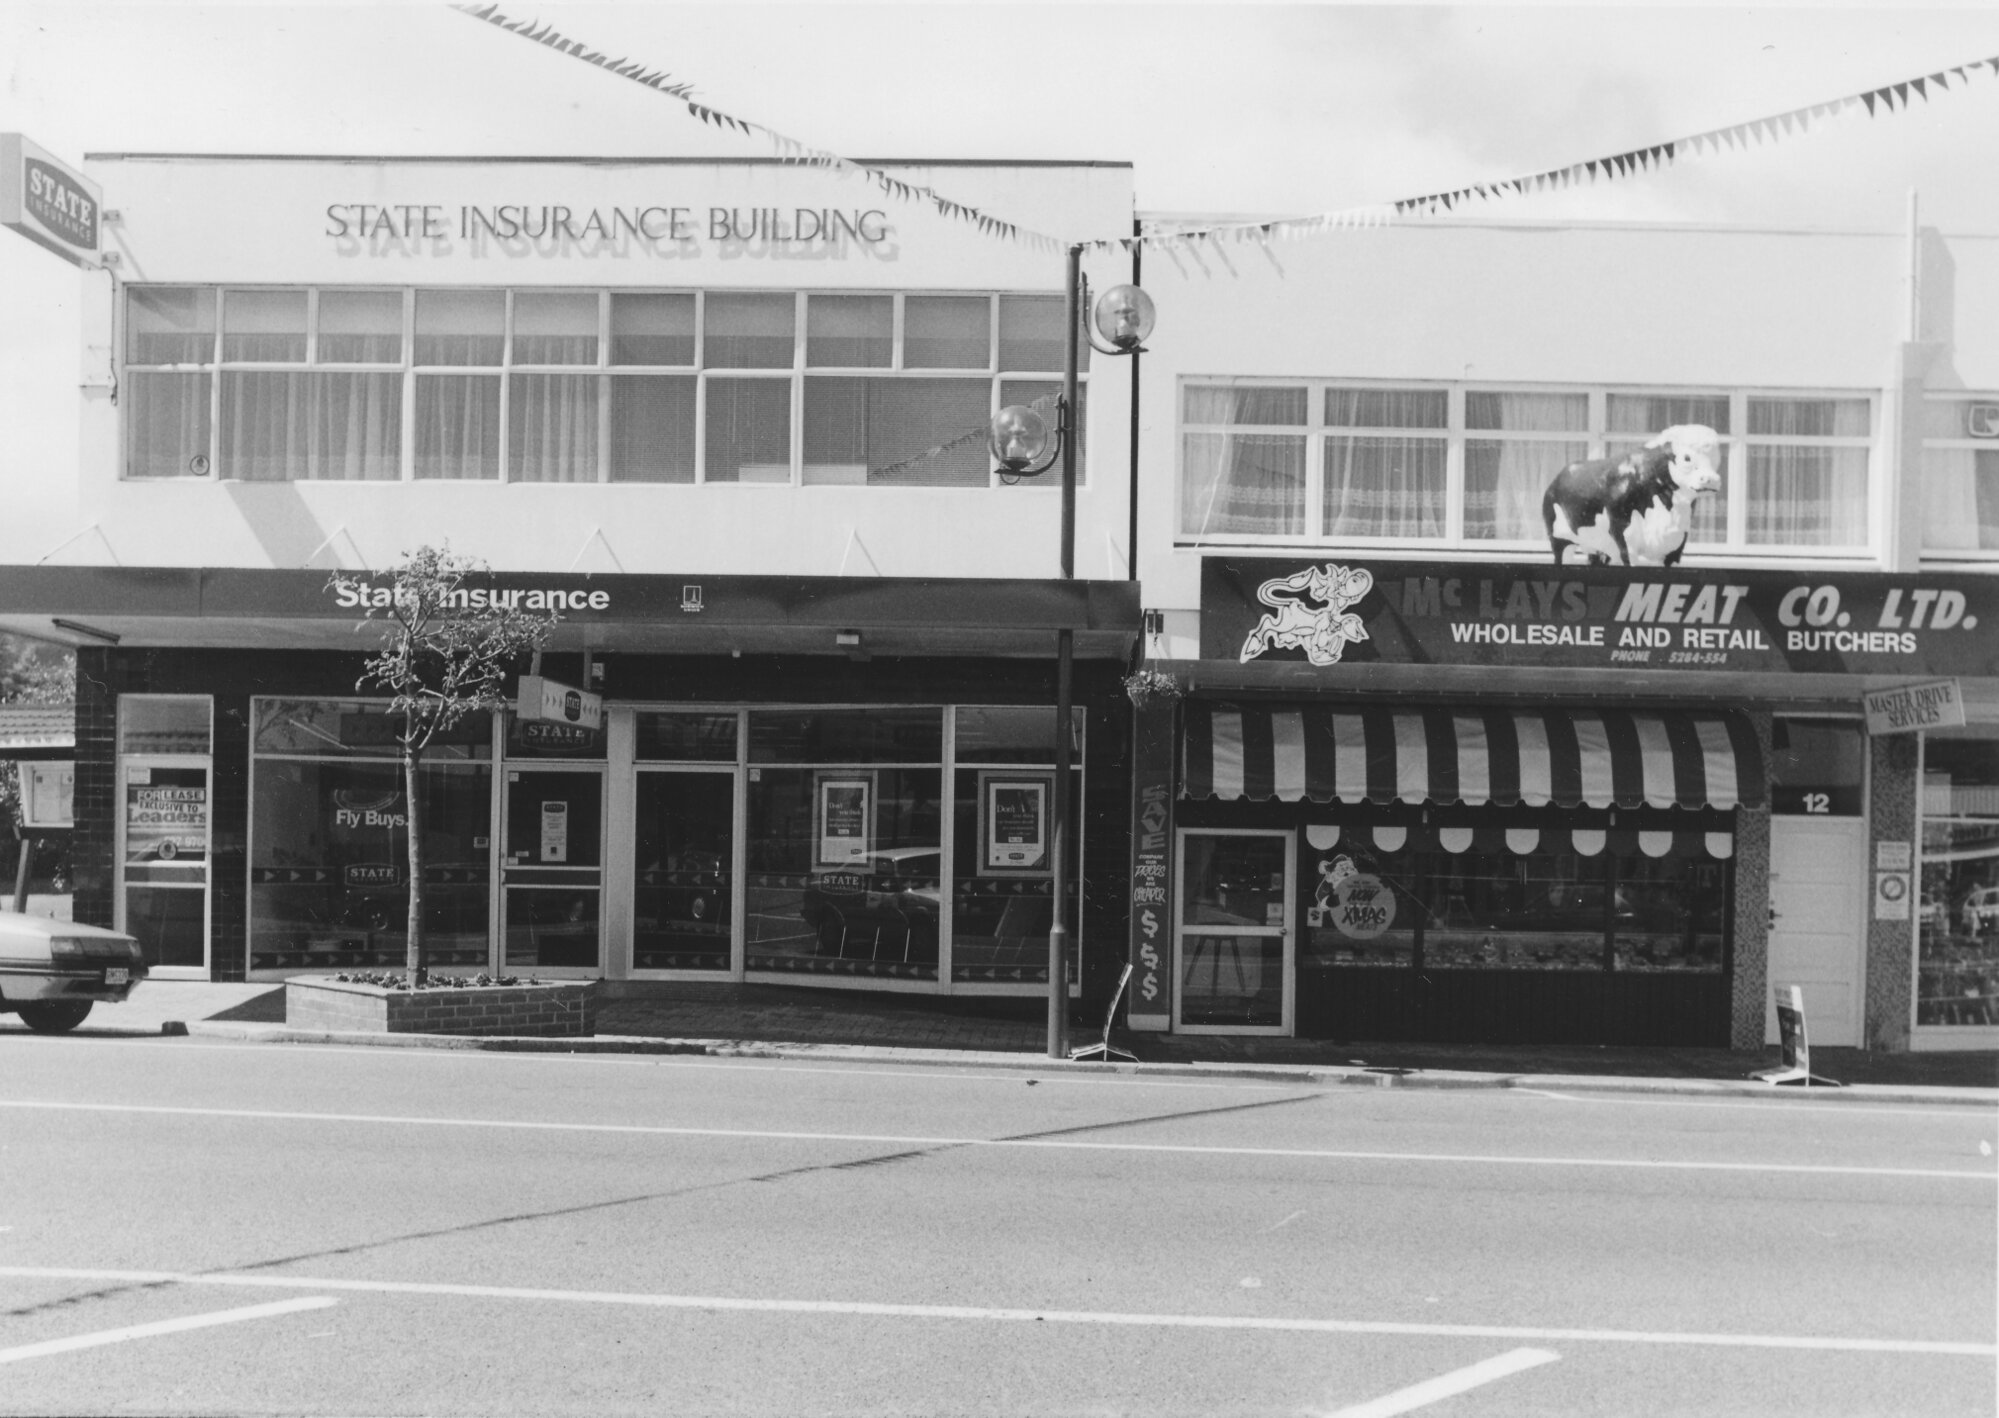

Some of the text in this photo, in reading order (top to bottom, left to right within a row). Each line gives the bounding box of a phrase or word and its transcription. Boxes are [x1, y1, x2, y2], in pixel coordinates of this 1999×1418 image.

[30, 167, 92, 226] STATE
[326, 203, 889, 243] STATE INSURANCE BUILDING
[335, 582, 611, 611] Stat Insurance
[1480, 578, 1588, 622] LAYS
[1614, 582, 1749, 625] MEAT
[1777, 584, 1851, 629] CO.
[1876, 588, 1978, 631] LTD.
[1450, 623, 1917, 653] WHOLESALE AND RETAIL BUTCHERS
[1610, 649, 1651, 662] PHONE
[1869, 684, 1953, 714] MASTER DRIVE
[1888, 706, 1941, 728] SERVICES
[527, 725, 585, 738] STATE
[138, 789, 200, 801] FOR LEASE
[1802, 793, 1830, 813] 12
[127, 807, 206, 823] Leaders
[139, 800, 199, 813] EXCLUSIVE TO
[335, 808, 361, 829] Fly
[1140, 784, 1167, 851] SAVE
[350, 867, 394, 878] STATE
[823, 875, 859, 886] STATE
[1134, 865, 1166, 878] PRICES
[1133, 886, 1167, 904] CHEAPER
[1341, 904, 1387, 927] XMAS
[1140, 908, 1159, 1001] $ $ $
